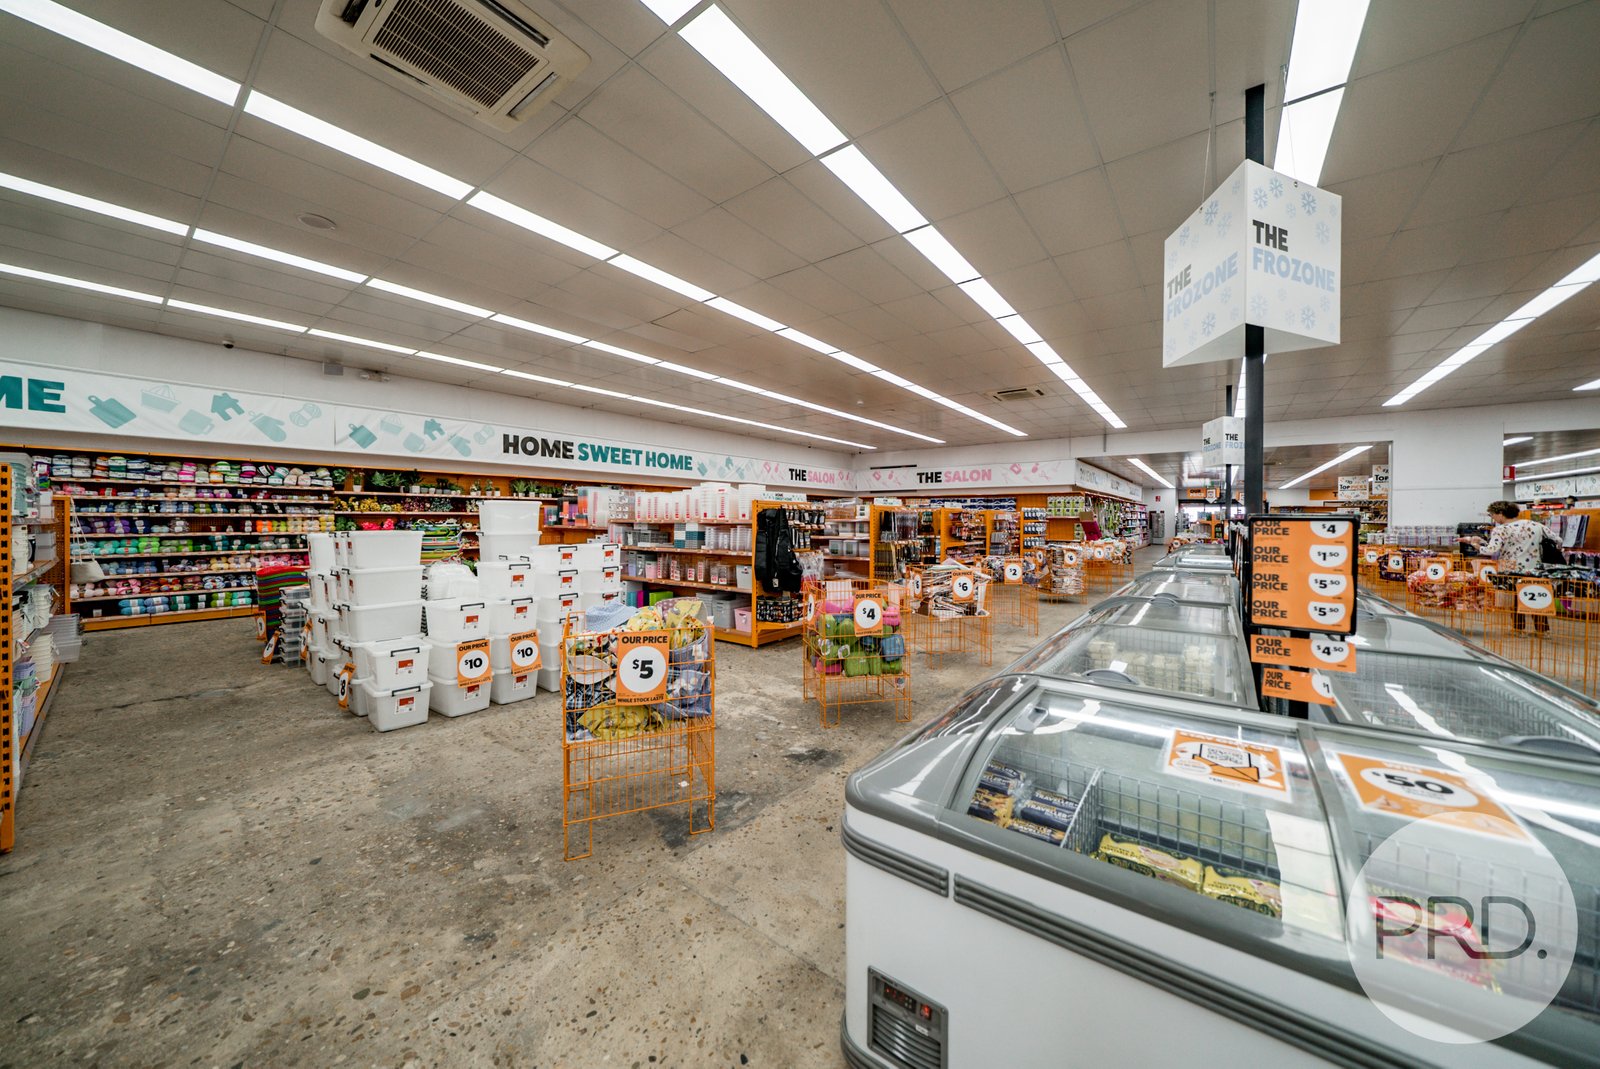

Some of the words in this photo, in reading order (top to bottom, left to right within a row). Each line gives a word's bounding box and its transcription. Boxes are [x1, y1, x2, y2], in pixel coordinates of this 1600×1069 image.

[1253, 219, 1288, 252] THE
[1253, 247, 1335, 292] FROZONE
[1167, 264, 1192, 299] THE
[1166, 252, 1239, 322] FROZONE
[1225, 433, 1239, 441] THE
[502, 434, 574, 460] HOME
[577, 442, 642, 466] SWEET
[645, 452, 693, 471] HOME
[789, 468, 807, 482] THE
[808, 470, 835, 484] SALON
[917, 471, 942, 484] THE
[944, 469, 991, 483] SALON
[1254, 527, 1290, 536] PRICE
[1322, 523, 1336, 534] $4
[1254, 546, 1281, 554] OUR
[1253, 555, 1289, 563] PRICE
[1253, 573, 1280, 582] OUR
[958, 582, 968, 591] $6
[1253, 581, 1288, 591] PRICE
[1252, 600, 1279, 609] OUR
[862, 608, 875, 620] $4
[1252, 609, 1288, 618] PRICE
[622, 636, 641, 644] OUR
[1256, 637, 1282, 647] OUR
[517, 647, 533, 658] $10
[1256, 646, 1291, 656] PRICE
[465, 658, 482, 669] $10
[632, 659, 653, 679] $5
[1266, 671, 1283, 680] OUR
[1265, 680, 1291, 690] PRICE
